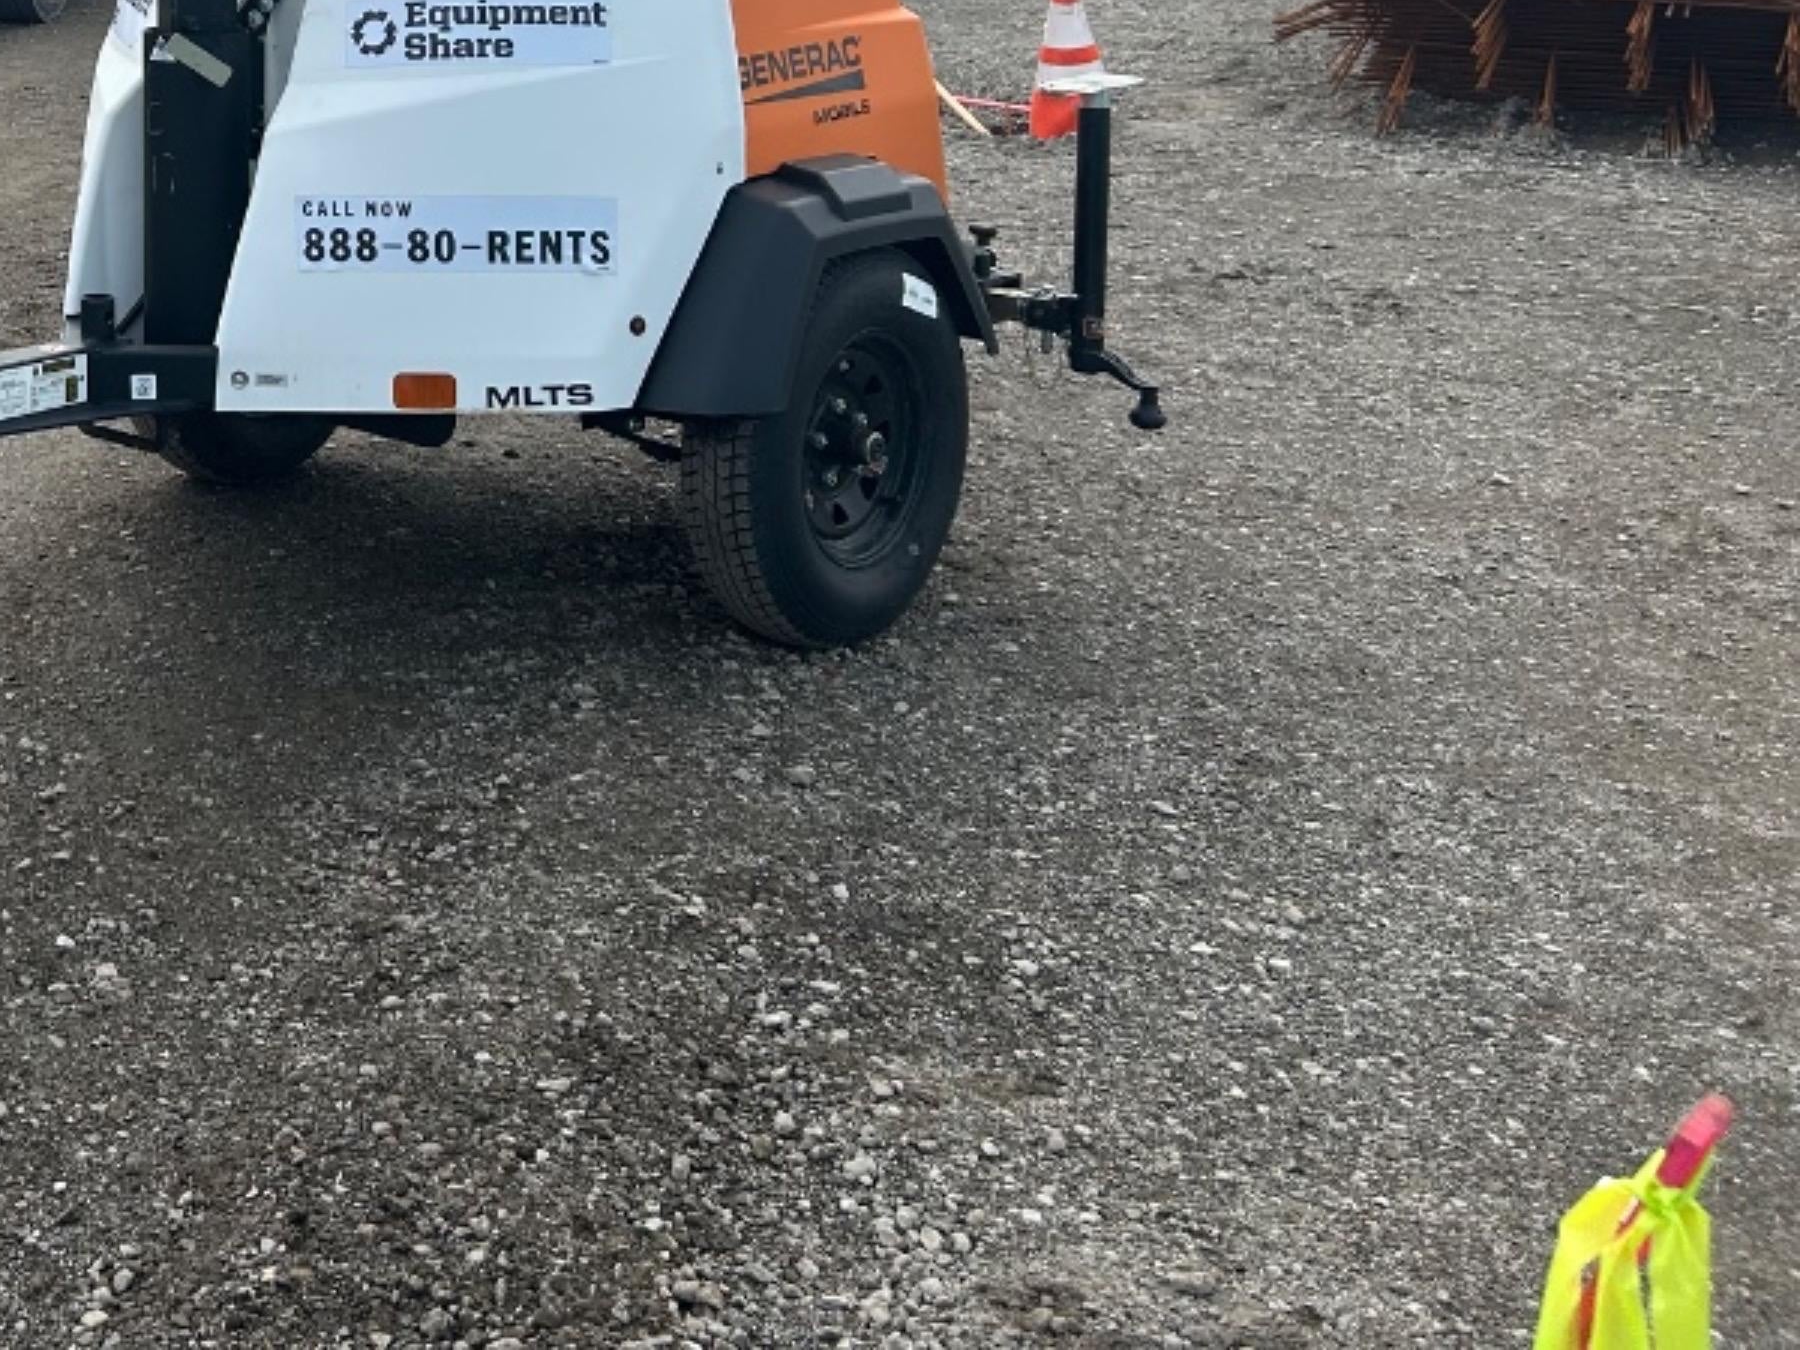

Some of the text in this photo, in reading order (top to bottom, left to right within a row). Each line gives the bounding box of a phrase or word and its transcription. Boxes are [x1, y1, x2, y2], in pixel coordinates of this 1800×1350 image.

[404, 33, 514, 61] Share
[302, 200, 412, 218] CALL NOW
[303, 227, 611, 264] 888-80-RENTS
[486, 384, 594, 409] MLTS
